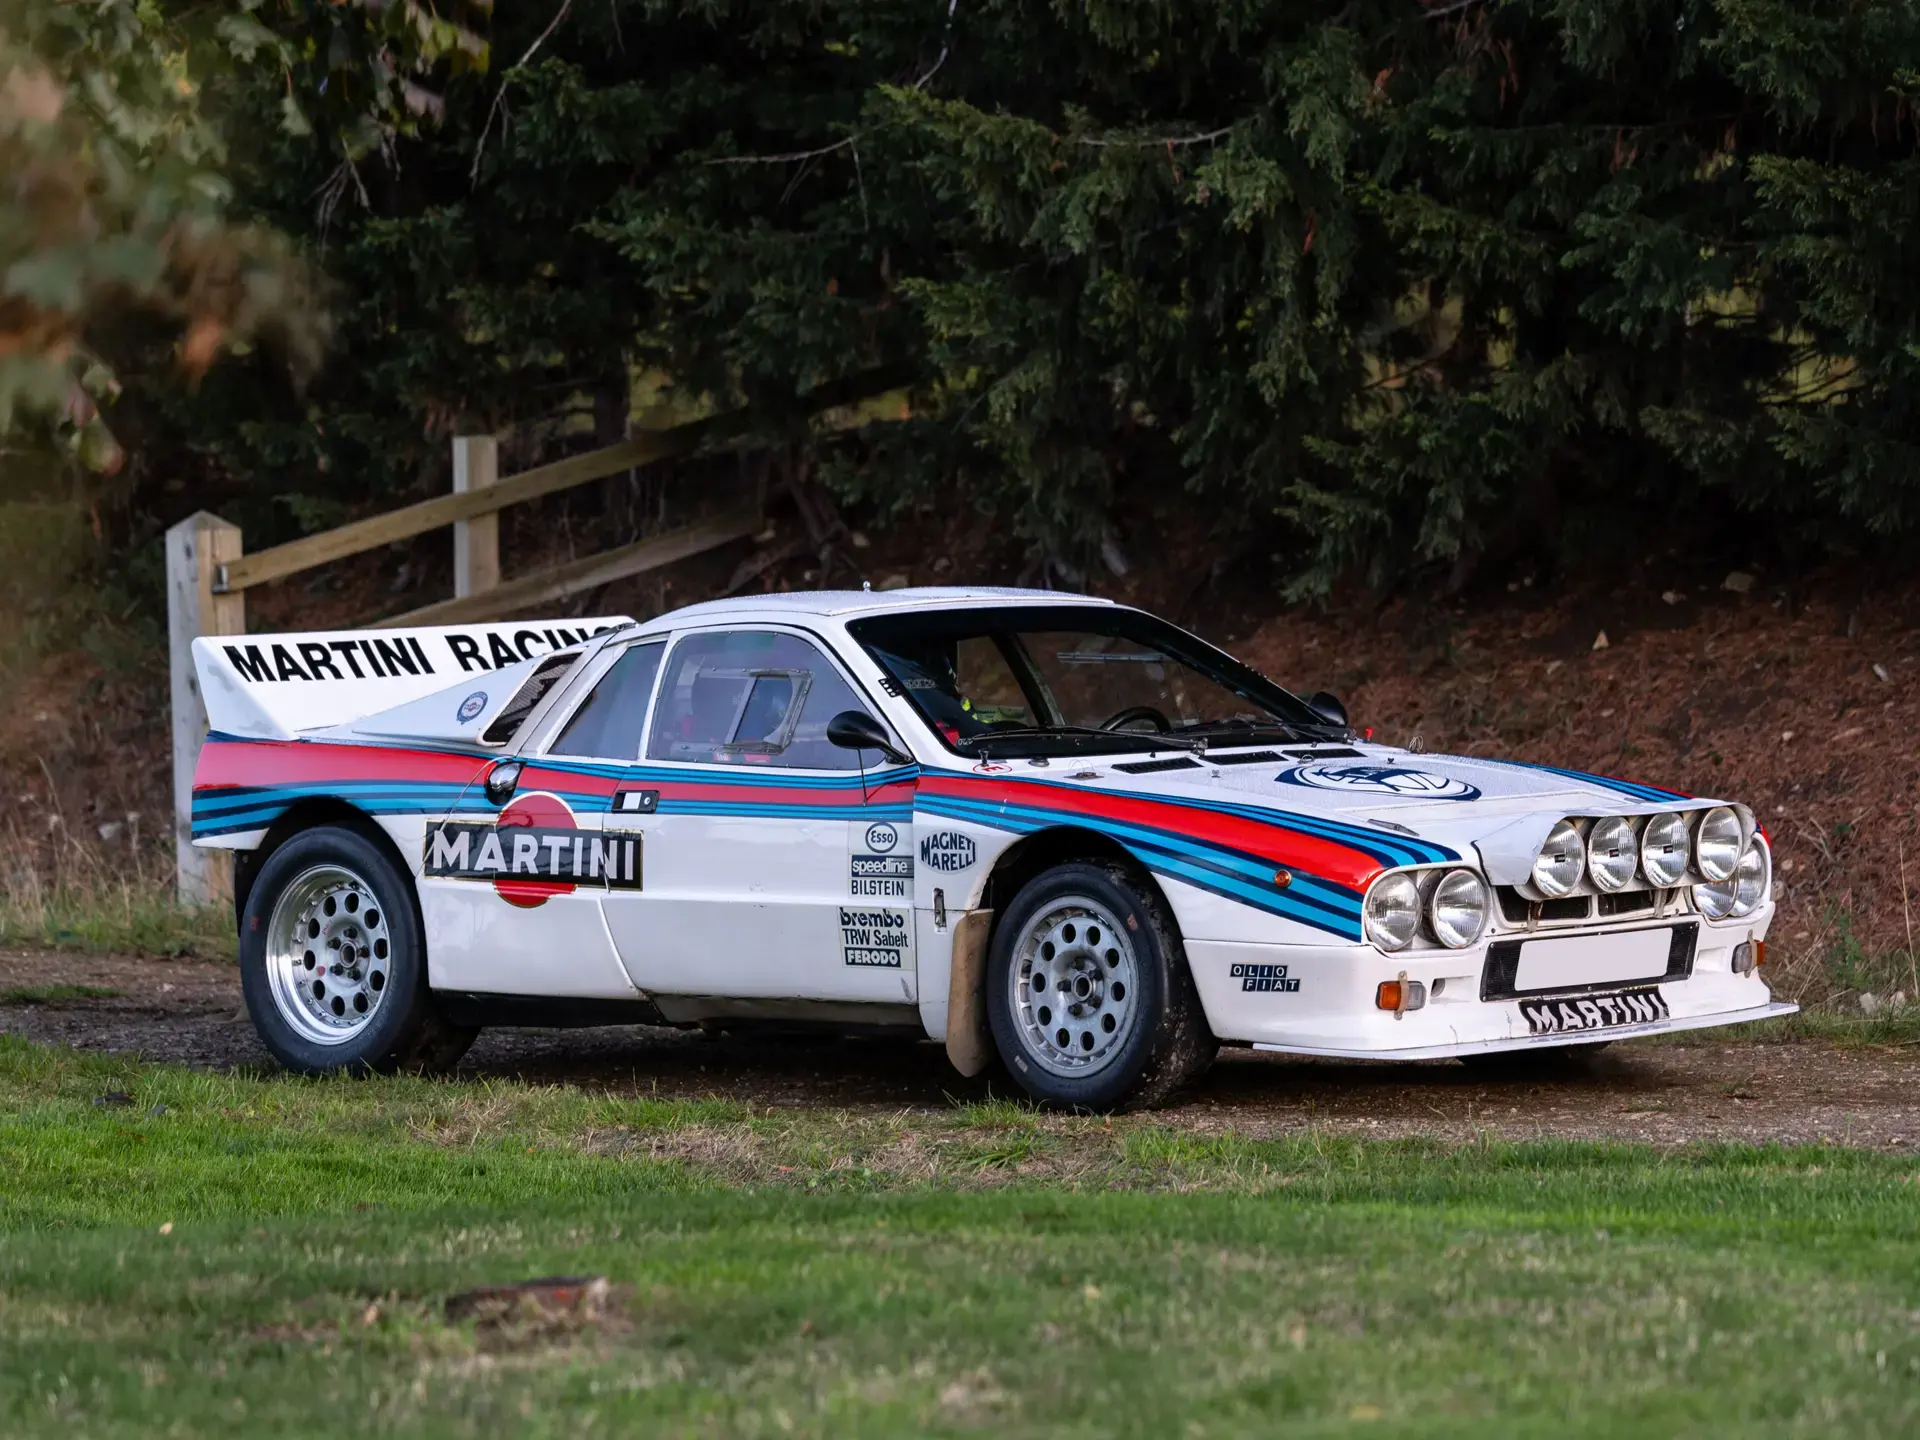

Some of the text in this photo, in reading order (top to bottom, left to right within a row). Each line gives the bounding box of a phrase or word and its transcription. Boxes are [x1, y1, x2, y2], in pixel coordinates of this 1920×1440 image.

[222, 626, 611, 682] MARTINI RACI
[871, 830, 893, 844] Esso
[921, 832, 976, 851] MAGNETI
[433, 830, 634, 880] MARTINI
[921, 849, 976, 871] MARELLI
[852, 858, 908, 875] speedline
[851, 880, 905, 896] BILSTEIN
[839, 906, 904, 928] brembo
[842, 928, 909, 947] TRW Sabelt
[847, 950, 898, 965] FERODO
[1233, 965, 1285, 976] OLIO
[1246, 980, 1297, 990] FIAT
[1527, 993, 1665, 1034] MARTINI
